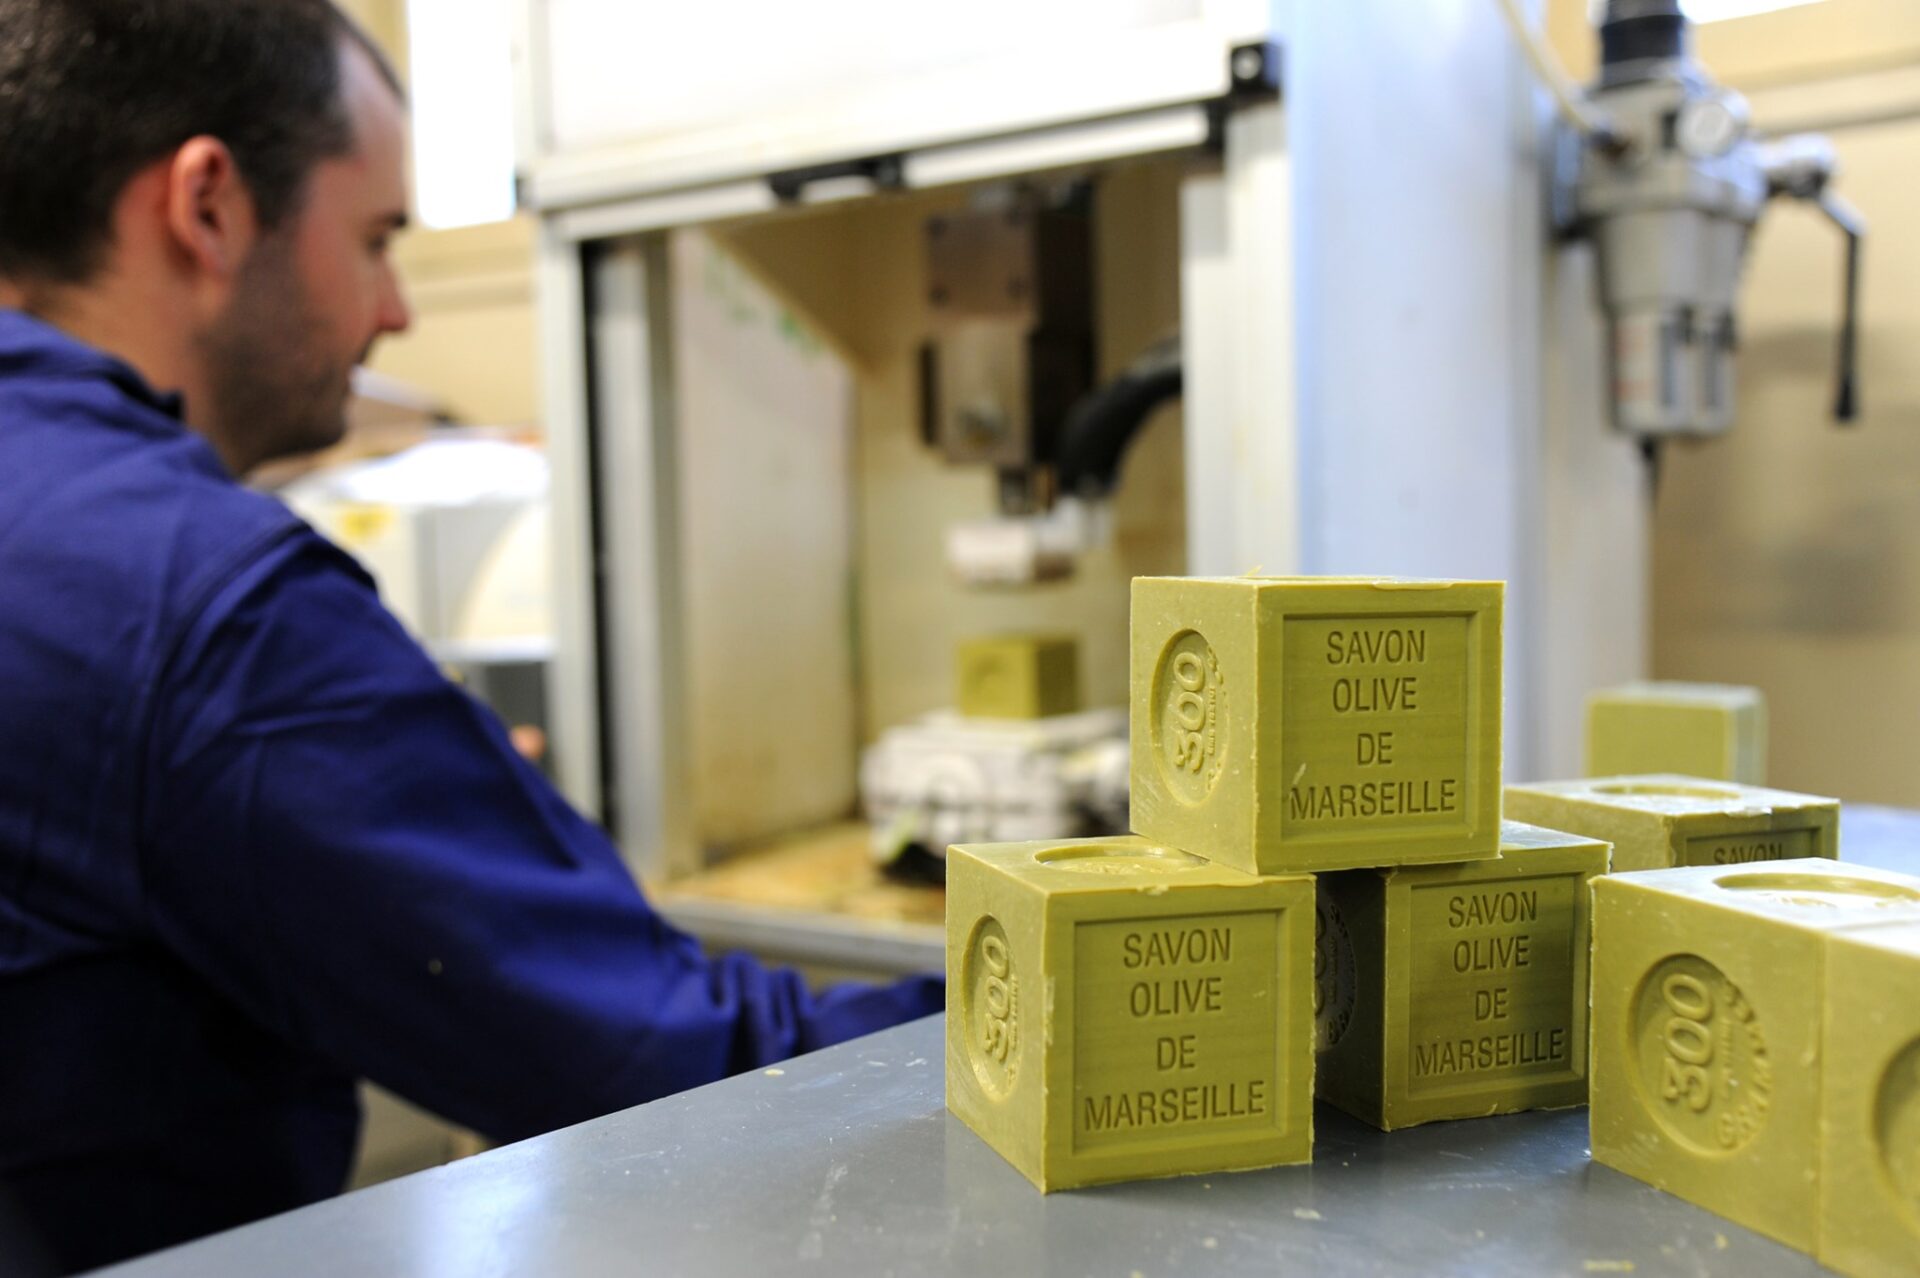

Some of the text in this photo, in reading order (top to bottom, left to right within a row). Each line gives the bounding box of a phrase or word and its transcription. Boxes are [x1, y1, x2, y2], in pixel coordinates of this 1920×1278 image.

[1326, 629, 1425, 665] SAVON
[1173, 651, 1206, 775] 300
[1332, 676, 1417, 713] OLIVE
[1356, 732, 1393, 766] DE
[1289, 779, 1456, 820] MARSEILLE
[1713, 842, 1782, 864] SAVON
[1448, 891, 1537, 929] SAVON
[1123, 927, 1231, 968] SAVON
[1453, 935, 1529, 974] OLIVE
[981, 934, 1011, 1065] 300
[1130, 977, 1222, 1018] OLIVE
[1475, 988, 1508, 1022] DE
[1156, 1035, 1196, 1071] DE
[1415, 1028, 1564, 1076] MARSEILLE
[1662, 972, 1716, 1113] 300
[1084, 1080, 1265, 1132] MARSEILLE
